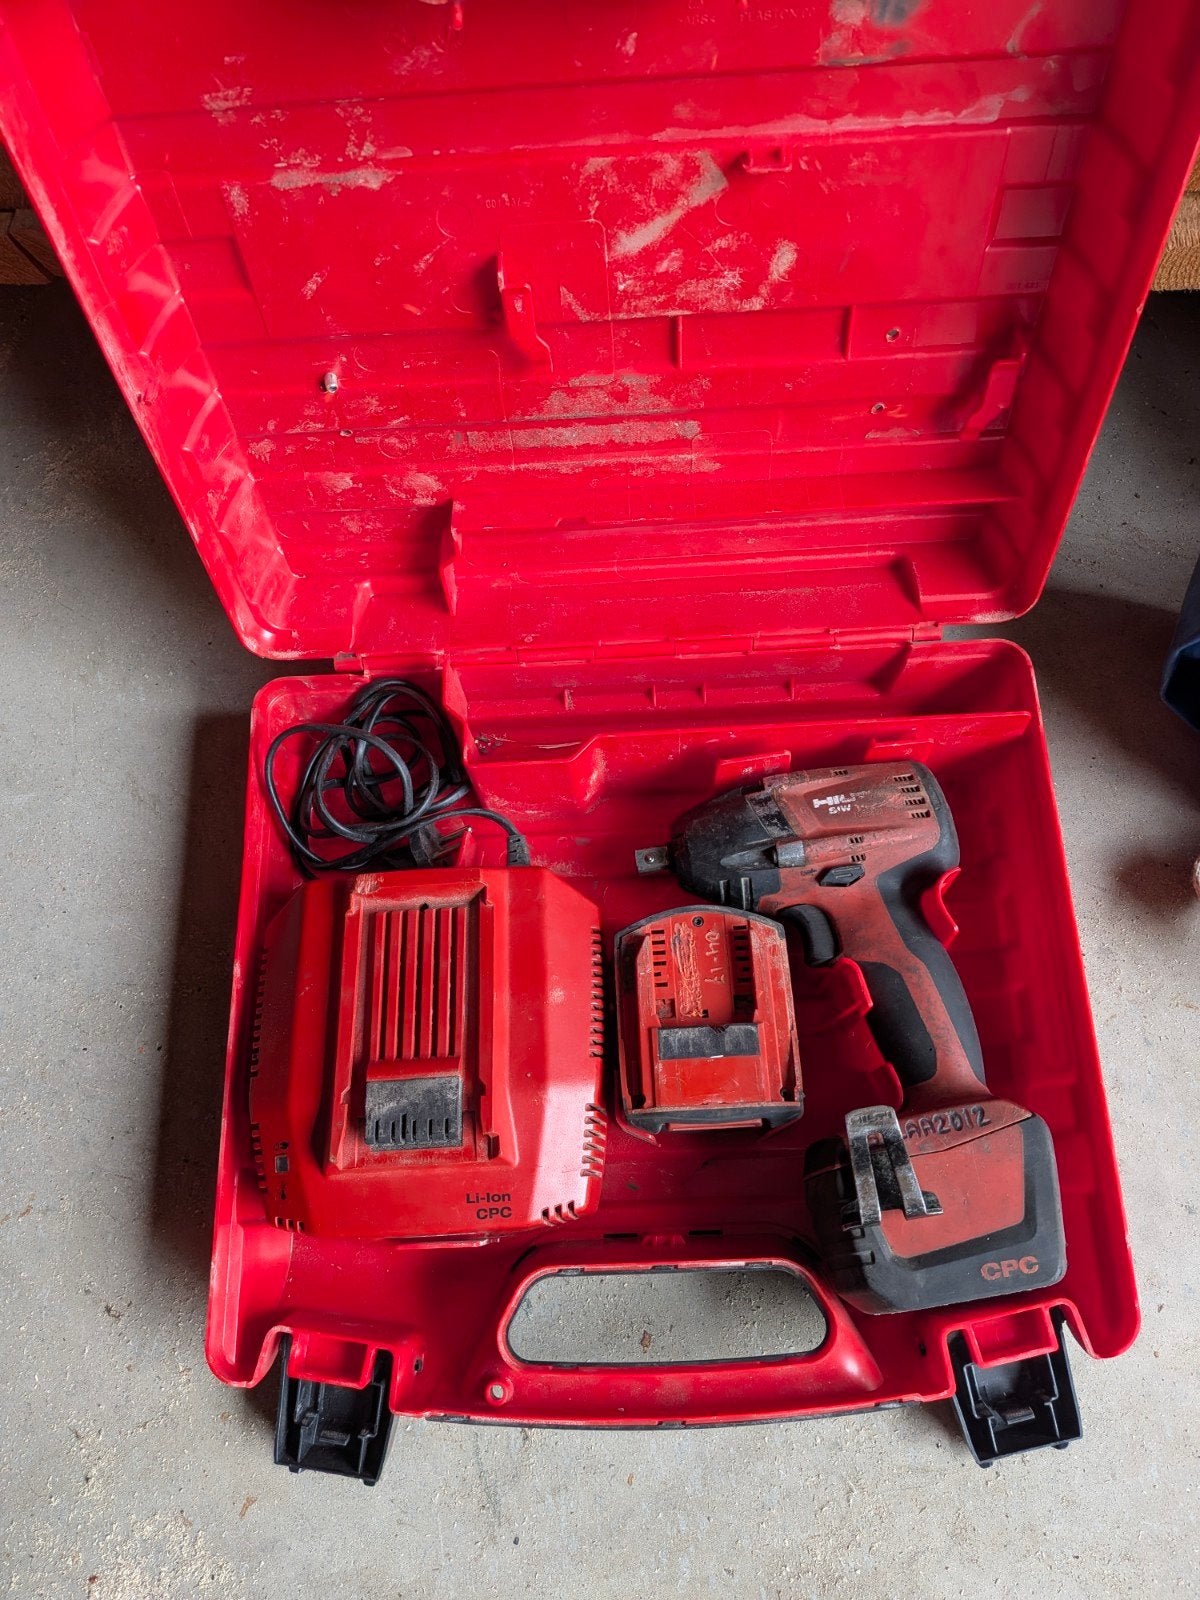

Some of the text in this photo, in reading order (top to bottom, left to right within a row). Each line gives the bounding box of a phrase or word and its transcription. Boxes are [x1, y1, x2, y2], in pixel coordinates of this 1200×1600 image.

[902, 1105, 991, 1140] AA2012
[465, 1192, 512, 1204] Li-Ion
[476, 1206, 513, 1220] CPC
[980, 1255, 1039, 1281] CPC
